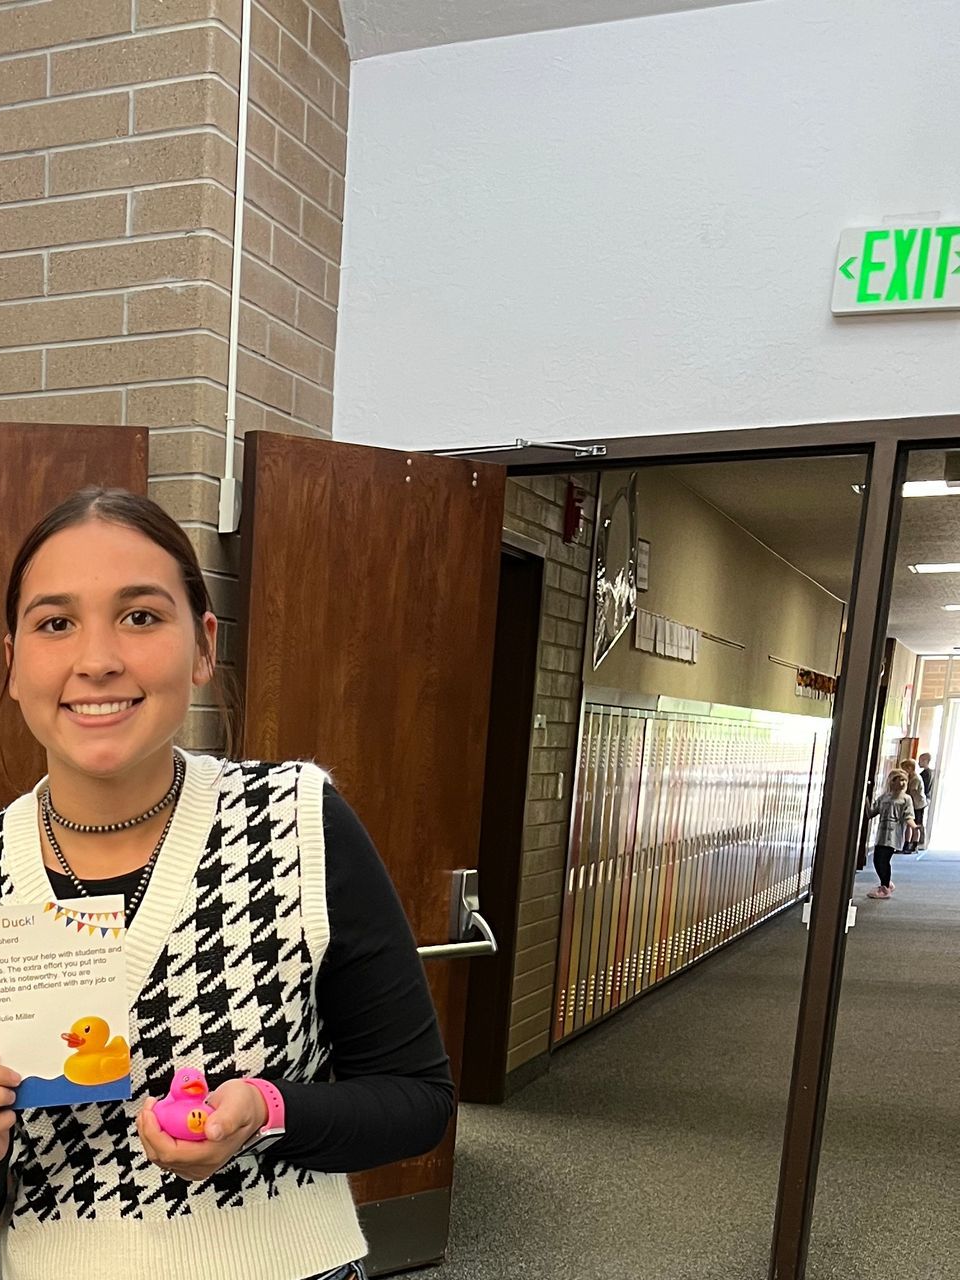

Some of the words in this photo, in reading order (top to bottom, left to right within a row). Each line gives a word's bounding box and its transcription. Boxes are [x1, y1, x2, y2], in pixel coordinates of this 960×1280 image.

[856, 226, 960, 303] EXIT
[1, 915, 35, 928] Duck!
[22, 954, 39, 963] your
[58, 950, 74, 958] with
[75, 948, 107, 957] students
[108, 945, 122, 953] and
[7, 965, 22, 973] The
[23, 964, 42, 972] extra
[43, 961, 63, 970] effort
[64, 960, 78, 969] you
[79, 957, 92, 967] put
[93, 957, 107, 965] into
[61, 970, 77, 978] You
[17, 984, 32, 992] and
[33, 980, 62, 990] efficient
[63, 979, 79, 987] with
[79, 978, 94, 986] any
[94, 976, 107, 986] job
[15, 1013, 36, 1021] Miller
